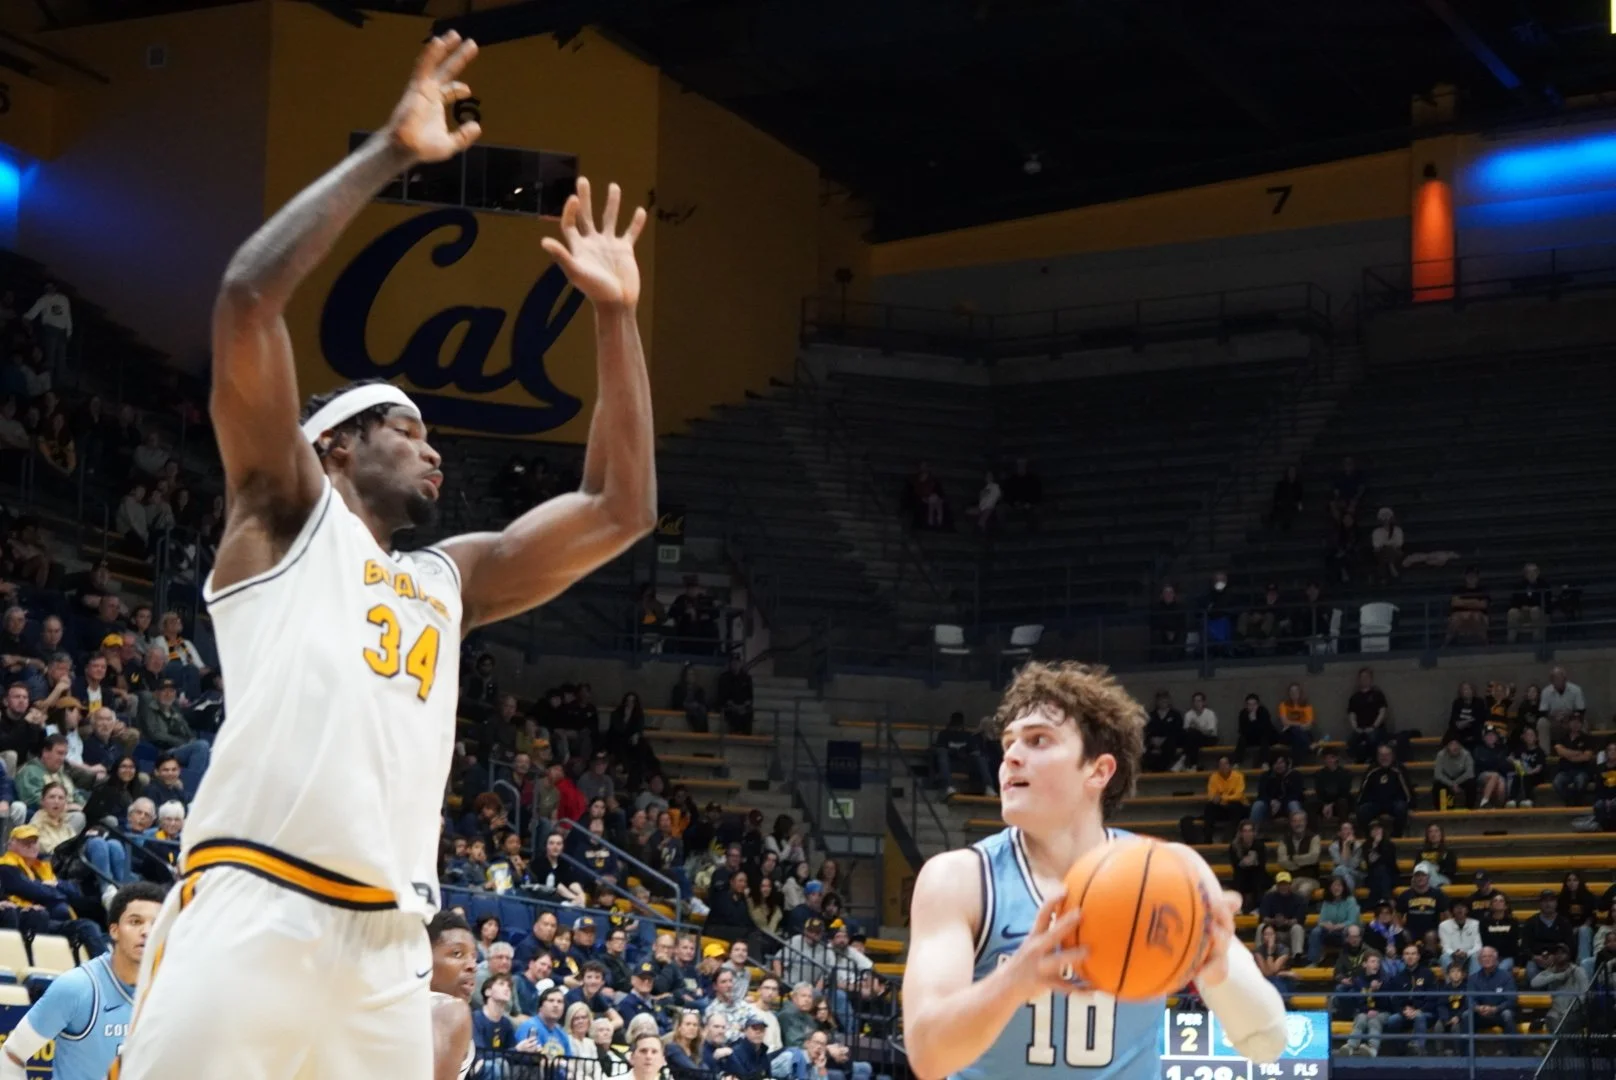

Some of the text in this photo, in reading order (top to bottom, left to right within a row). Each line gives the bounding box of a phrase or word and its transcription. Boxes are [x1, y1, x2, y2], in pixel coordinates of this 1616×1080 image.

[1265, 185, 1292, 215] 7
[320, 206, 586, 435] Cal
[363, 603, 440, 703] 34
[1026, 989, 1117, 1068] 10
[1180, 1027, 1198, 1052] 2
